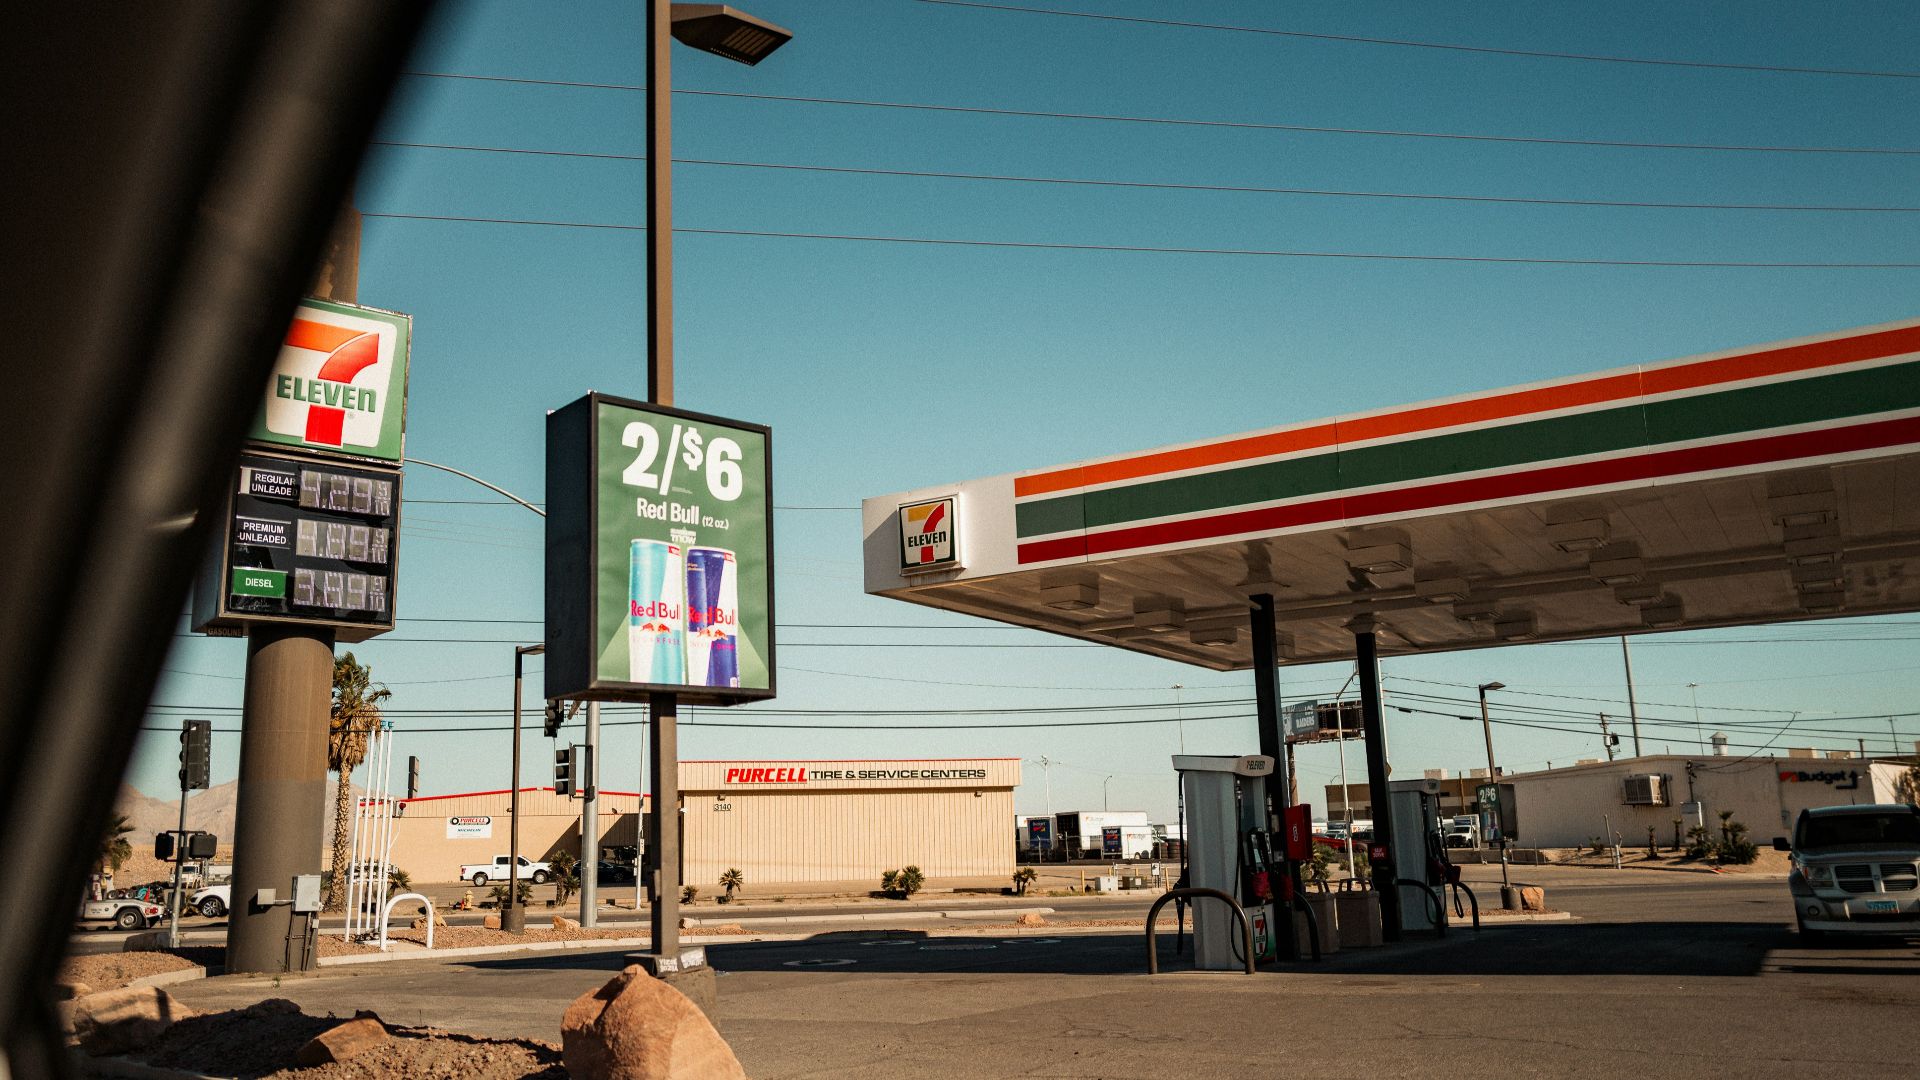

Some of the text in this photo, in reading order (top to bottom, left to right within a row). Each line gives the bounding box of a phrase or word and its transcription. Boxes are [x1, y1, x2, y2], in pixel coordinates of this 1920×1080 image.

[622, 421, 743, 501] 2/$6
[255, 473, 296, 485] REGULAR
[251, 484, 298, 496] UNLEADED
[637, 497, 667, 520] Red
[670, 502, 699, 525] Bull
[243, 522, 284, 534] PREMIUM
[908, 502, 944, 563] 7
[239, 533, 287, 545] UNLEADED
[245, 577, 274, 588] DIESEL
[631, 600, 656, 618] Red
[207, 626, 242, 636] GASOLINE
[726, 767, 986, 783] PURCELL TIRE & SERVICE CENTERS
[1798, 770, 1847, 785] Budget
[713, 803, 732, 812] 3140
